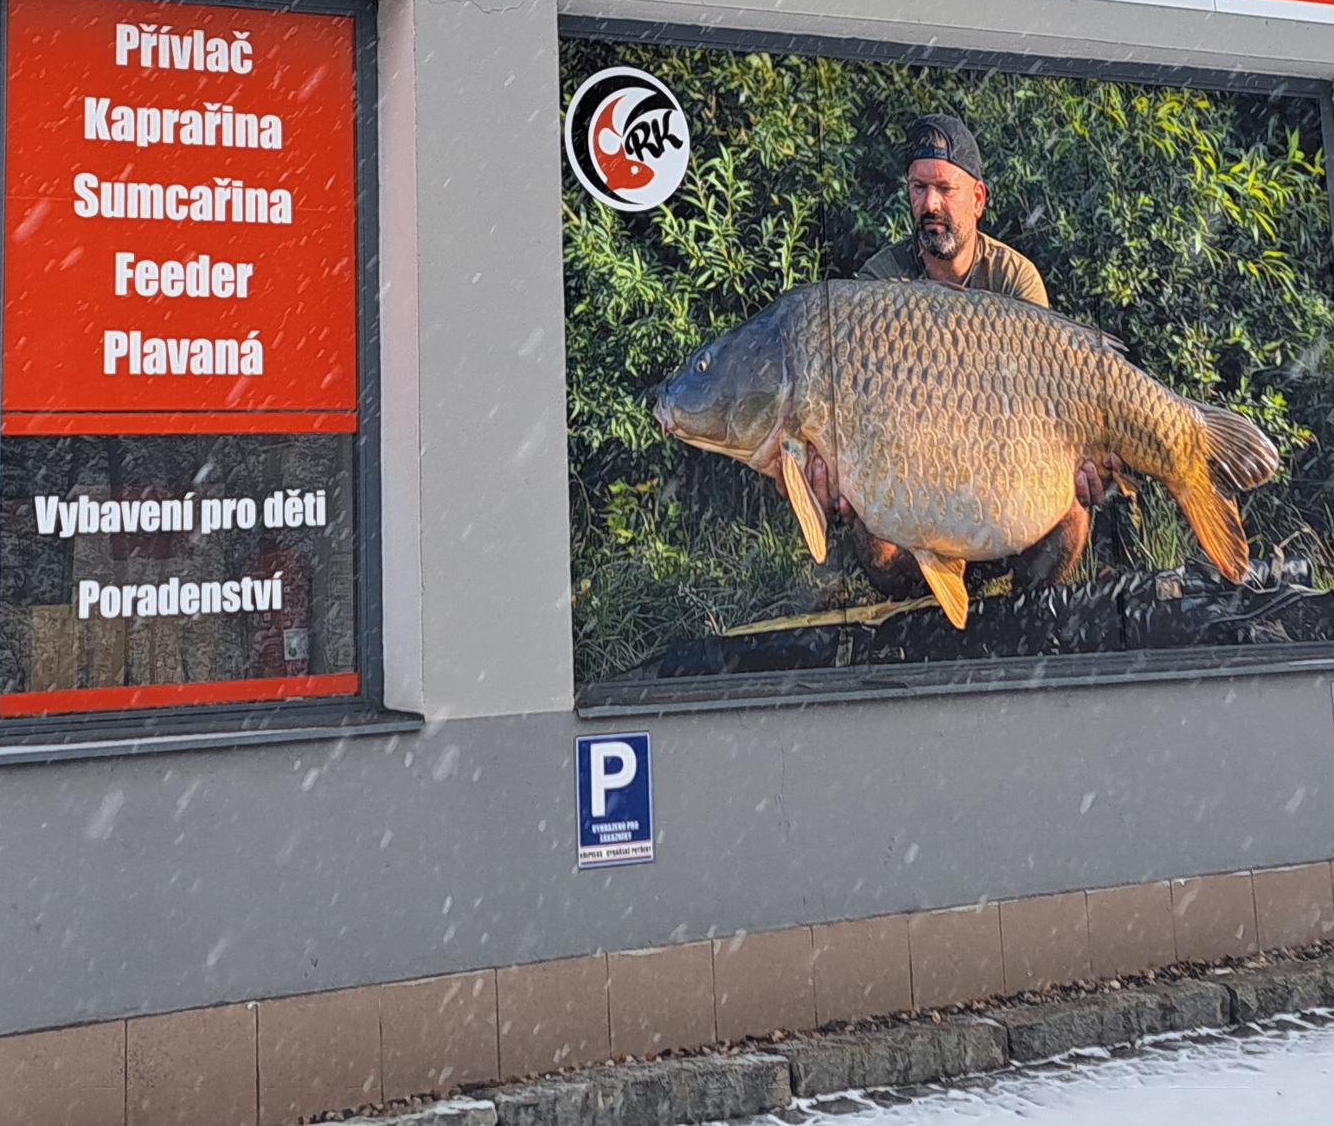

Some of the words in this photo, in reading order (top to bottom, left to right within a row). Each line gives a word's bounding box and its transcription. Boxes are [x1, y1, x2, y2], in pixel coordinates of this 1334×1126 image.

[114, 23, 254, 75] Přívlač
[83, 96, 283, 150] Kaprařina
[624, 110, 684, 162] RK
[73, 172, 293, 225] Sumcařina
[114, 252, 254, 299] Feeder
[103, 328, 264, 376] Plavaná
[34, 491, 196, 538] Vybavení
[200, 496, 257, 534] pro
[263, 488, 327, 528] děti
[77, 570, 283, 619] Poradenství
[590, 741, 637, 818] P
